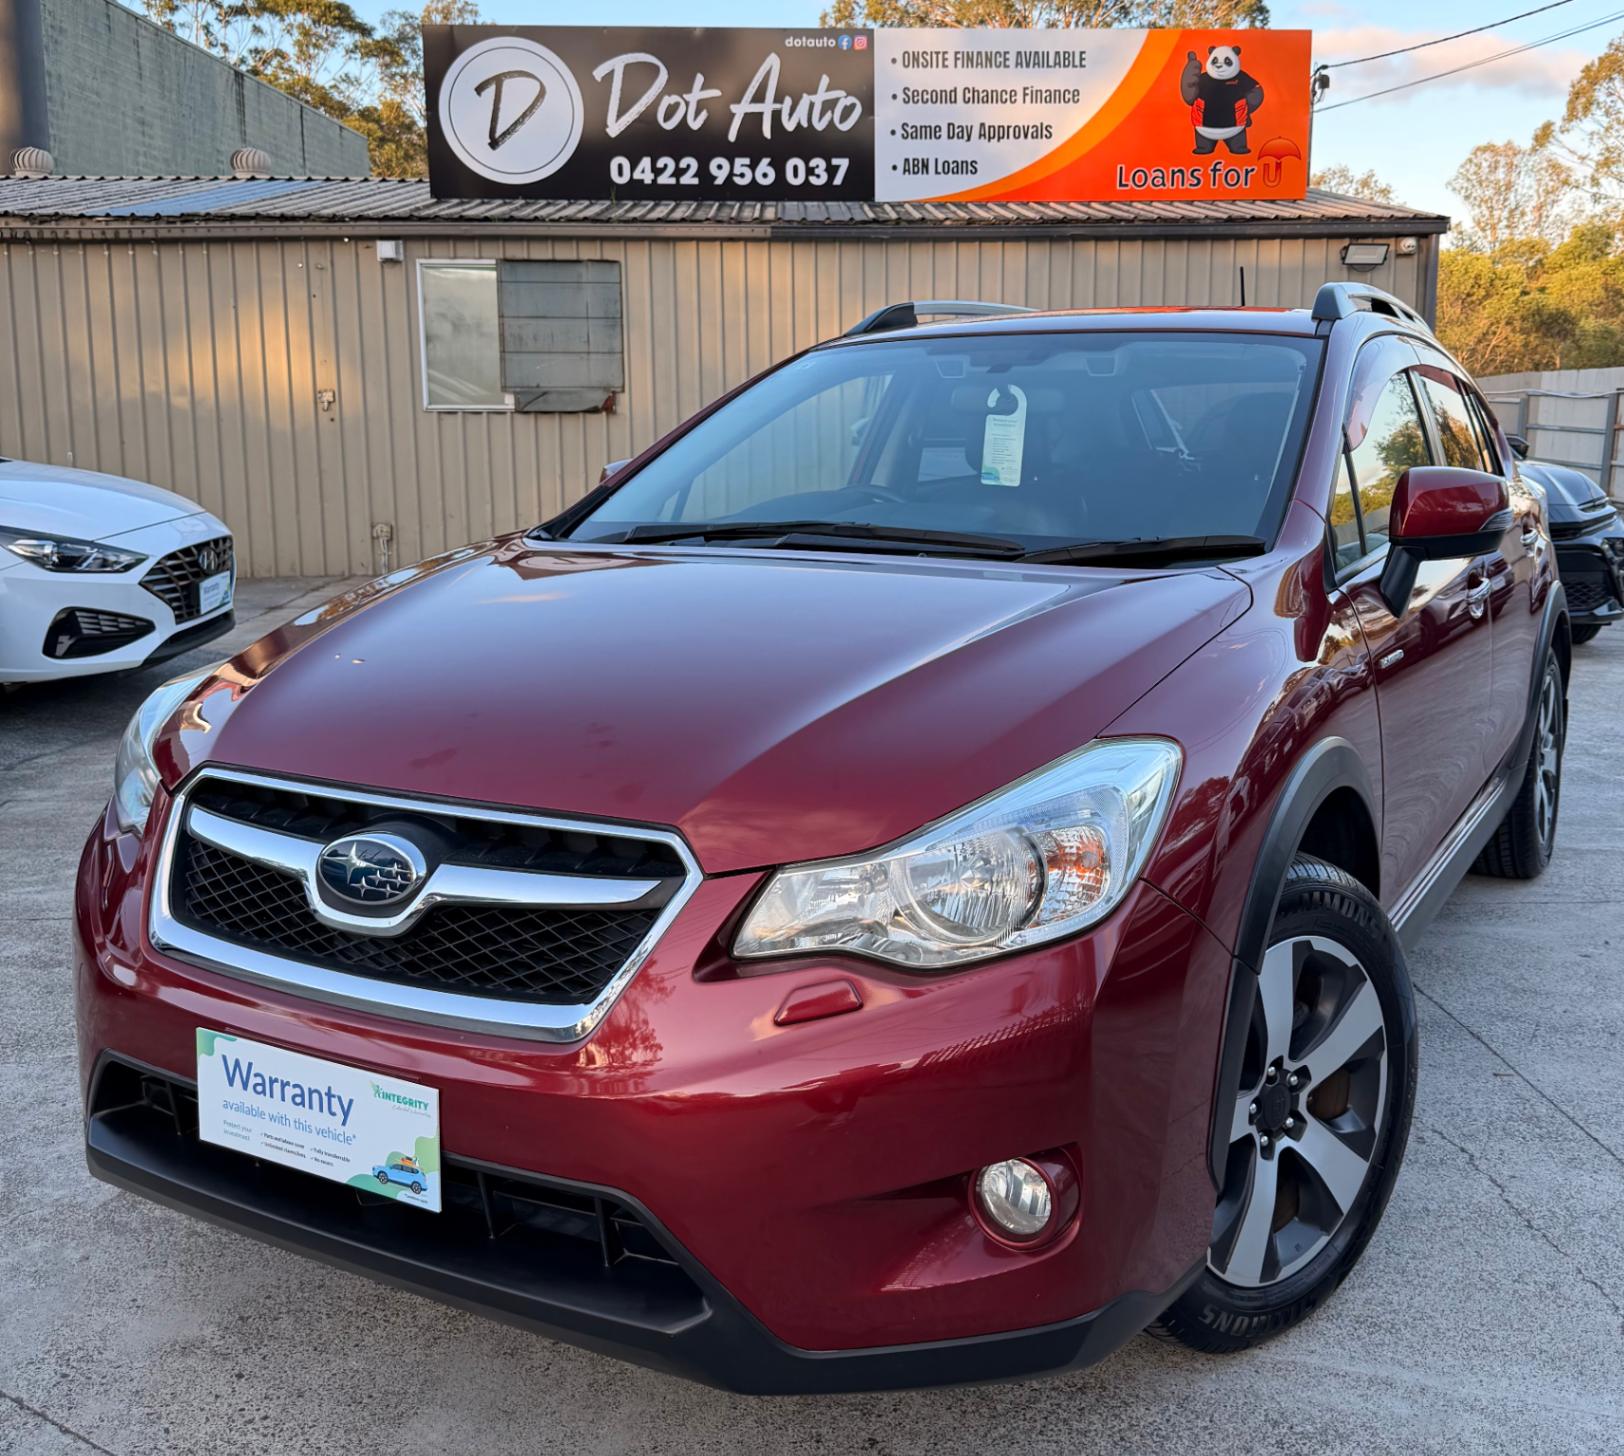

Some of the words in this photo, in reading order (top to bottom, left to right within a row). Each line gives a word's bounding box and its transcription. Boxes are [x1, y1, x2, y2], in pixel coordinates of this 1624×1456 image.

[784, 35, 836, 49] dotauto
[902, 50, 949, 70] ONSITE
[953, 50, 1011, 70] FINANCE
[1014, 50, 1087, 70] AVAILABLE
[592, 52, 722, 138] Dot
[728, 52, 863, 143] Auto
[902, 86, 958, 105] Second
[962, 86, 1018, 105] Chance
[1022, 85, 1080, 105] Finance
[474, 69, 547, 151] D
[901, 122, 943, 141] Same
[946, 122, 974, 143] Day
[978, 122, 1053, 143] Approvals
[609, 155, 700, 186] 0422
[709, 156, 776, 186] 956
[785, 157, 850, 186] 037
[902, 157, 930, 176] ABN
[934, 157, 978, 176] Loans
[1116, 164, 1202, 190] Loans
[1209, 159, 1256, 189] for
[221, 1054, 354, 1127] Warranty
[382, 1089, 429, 1112] INTEGRITY
[223, 1099, 266, 1120] available
[268, 1112, 291, 1128] with
[293, 1117, 313, 1134] this
